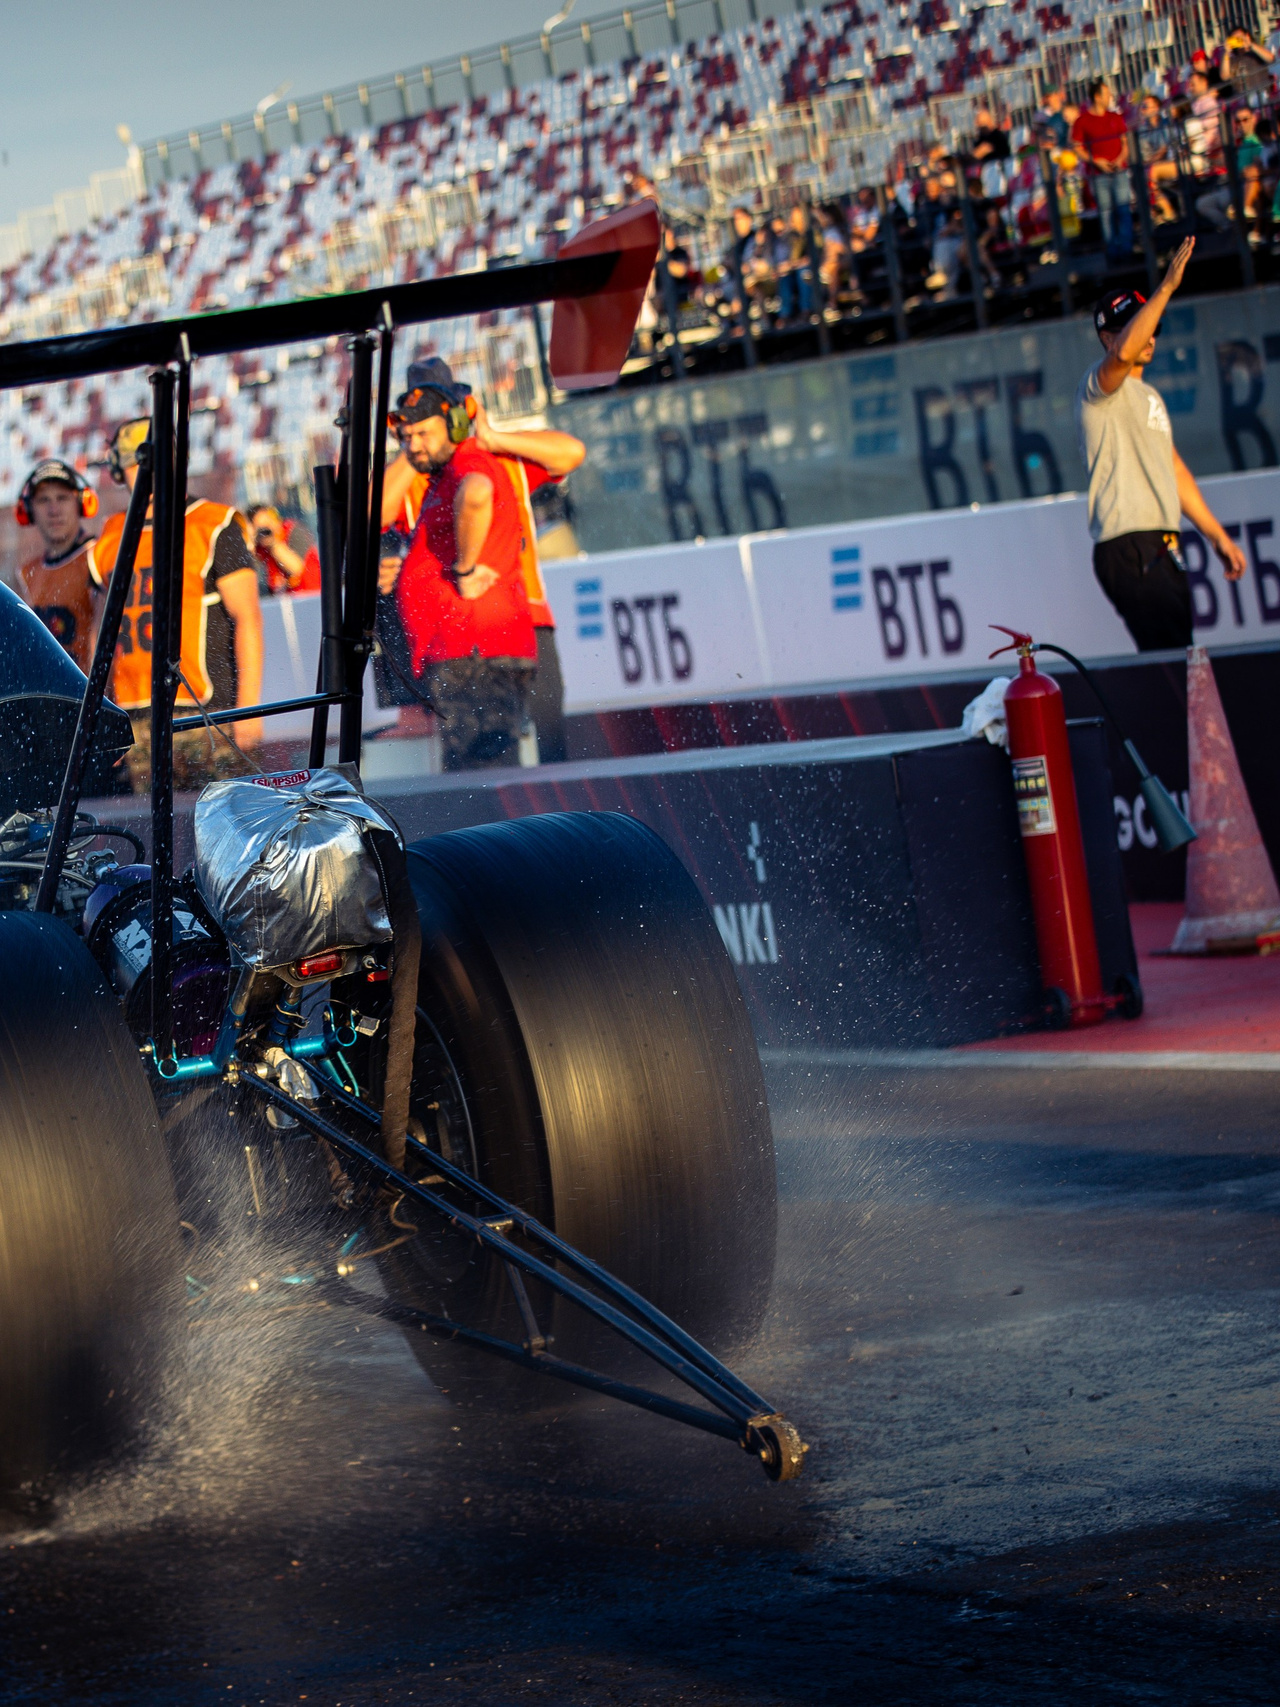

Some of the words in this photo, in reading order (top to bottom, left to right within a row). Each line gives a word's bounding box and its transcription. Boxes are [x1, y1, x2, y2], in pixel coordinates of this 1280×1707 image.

[611, 591, 694, 685] ВТБ
[871, 557, 965, 660] ВТБ
[256, 772, 307, 787] SIMPSON
